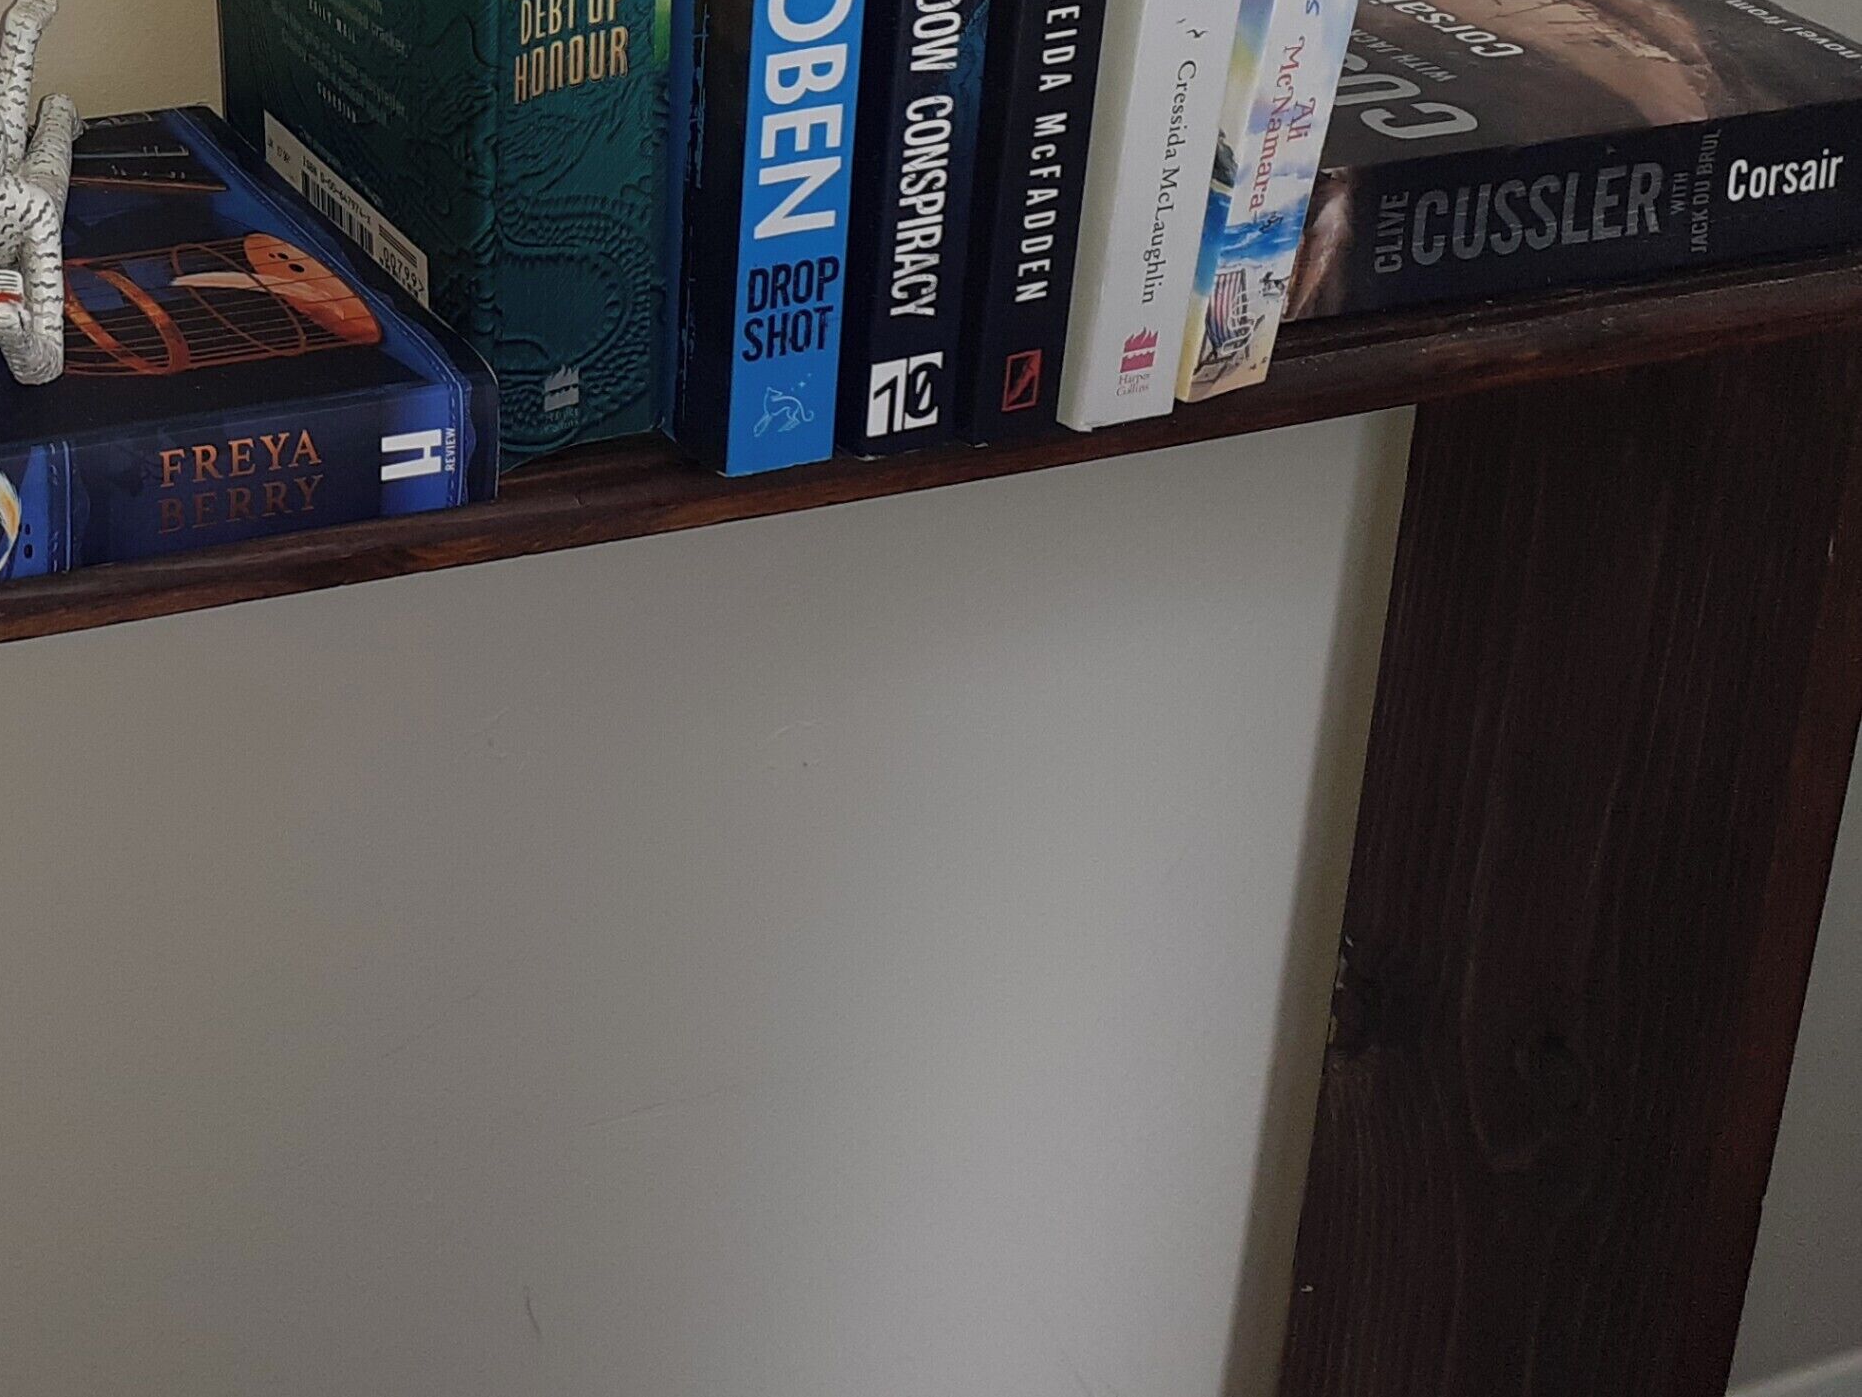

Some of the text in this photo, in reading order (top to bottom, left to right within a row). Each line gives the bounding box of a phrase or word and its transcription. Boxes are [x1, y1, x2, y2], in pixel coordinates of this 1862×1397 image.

[514, 25, 629, 104] HONOUR
[1392, 54, 1458, 83] WITH
[1782, 26, 1862, 60] novel
[1248, 35, 1307, 213] McNamara
[1285, 96, 1317, 144] Ali
[1140, 58, 1197, 306] Cressida McLaughlin
[1670, 171, 1689, 215] WITH
[1691, 128, 1722, 253] JACK DU BRUL
[1727, 148, 1844, 202] Corsair
[890, 94, 954, 318] CONSPIRACY
[1373, 189, 1410, 275] CLIVE
[1411, 161, 1664, 267] CUSSLER
[747, 255, 839, 314] DROP
[741, 305, 834, 363] SHOT
[158, 429, 323, 488] FREYA
[445, 427, 457, 475] REVIEW
[157, 473, 325, 534] BERRY
